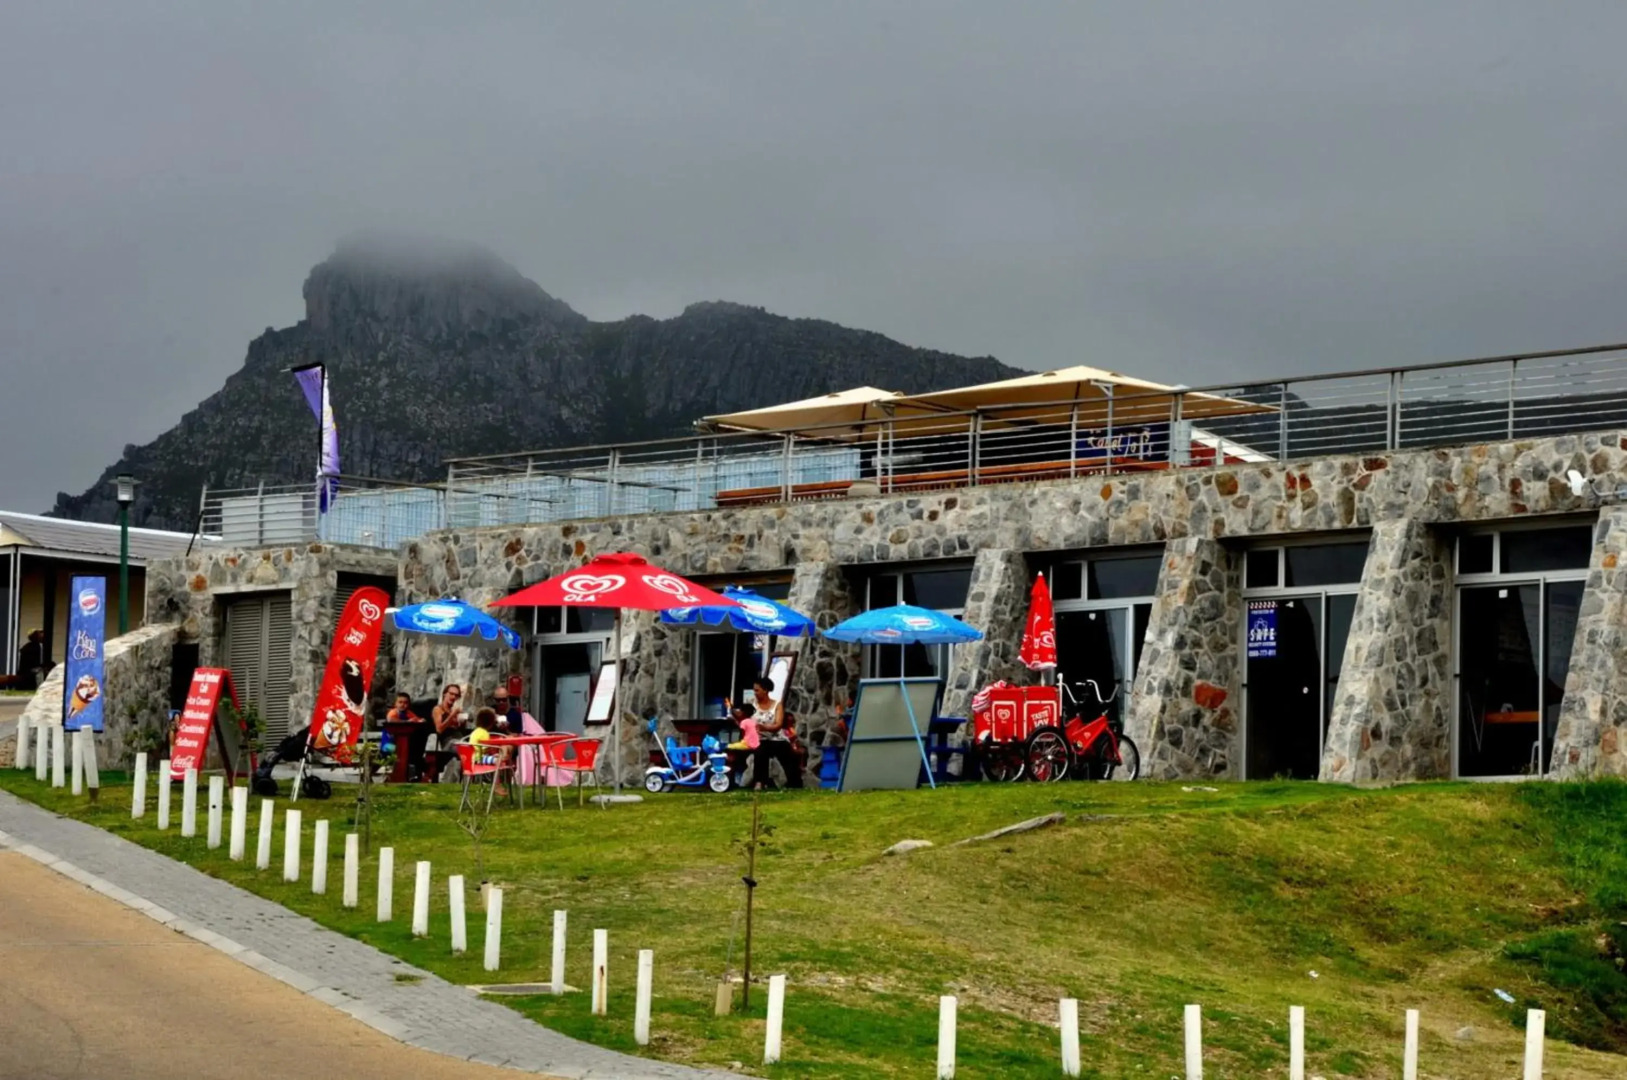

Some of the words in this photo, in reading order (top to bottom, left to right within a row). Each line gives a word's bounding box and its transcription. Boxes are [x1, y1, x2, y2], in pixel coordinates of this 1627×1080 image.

[563, 594, 595, 602] OLA
[77, 629, 96, 649] King
[1250, 628, 1275, 641] SAFE
[73, 644, 96, 660] Cone
